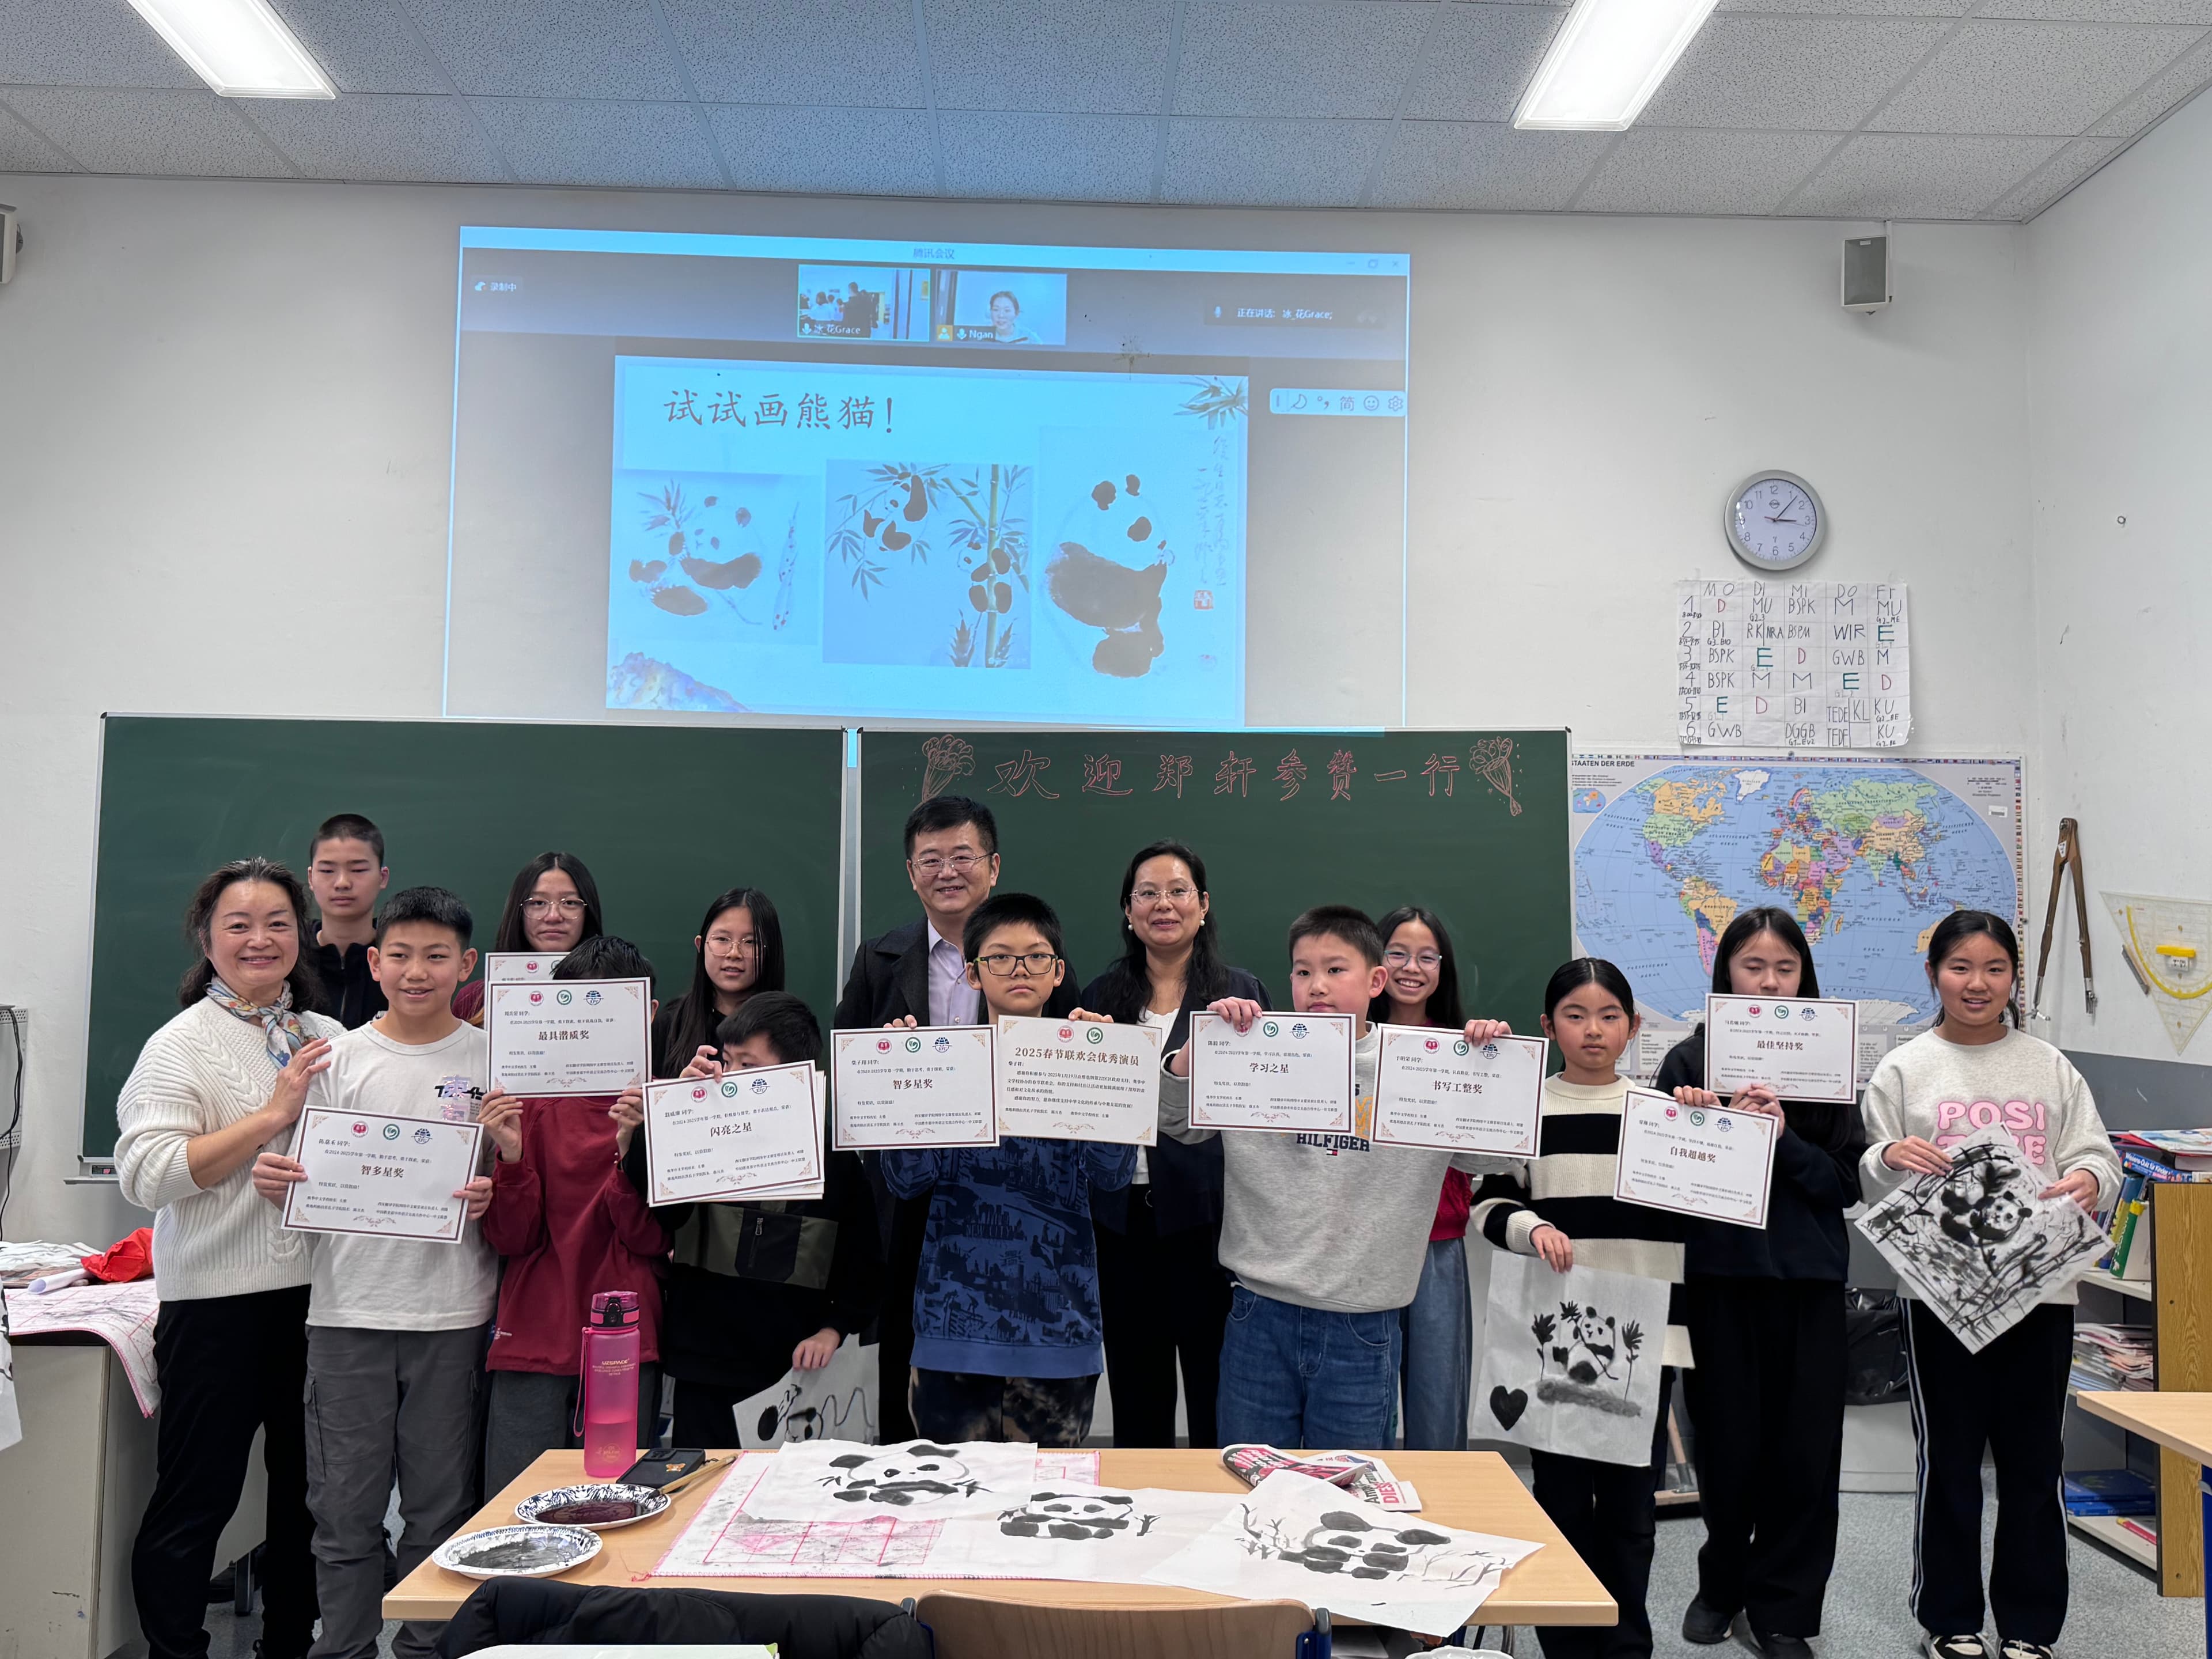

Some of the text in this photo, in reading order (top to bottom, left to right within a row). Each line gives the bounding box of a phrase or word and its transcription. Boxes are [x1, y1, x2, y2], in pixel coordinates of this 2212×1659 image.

[913, 247, 955, 260] 腾讯会议
[969, 329, 994, 339] Ngan
[1339, 395, 1355, 411] 简
[1755, 491, 1762, 499] 11
[1770, 485, 1778, 494] 12
[1789, 491, 1792, 499] 1
[1744, 500, 1753, 510] 10
[1798, 501, 1805, 510] 2
[1805, 516, 1810, 525] 3
[1744, 532, 1751, 541] 8
[1800, 532, 1805, 541] 4
[1757, 543, 1763, 552] 7
[1772, 546, 1778, 556] 6
[1788, 543, 1794, 551] 5
[1791, 584, 1807, 598] MI
[1838, 584, 1857, 598] DO
[1718, 599, 1726, 613] D
[1753, 597, 1772, 614] MU
[1789, 597, 1815, 615] BSPK
[1835, 597, 1853, 615] M
[1877, 600, 1902, 616] MU
[1682, 621, 1693, 638] 2
[1713, 620, 1725, 638] BI
[1834, 624, 1866, 641] WIR
[1878, 624, 1895, 642] E
[1684, 645, 1691, 662] 3
[1709, 647, 1734, 663] BSPK
[1757, 647, 1773, 667] E
[1798, 647, 1806, 664] D
[1832, 649, 1865, 665] GWB
[1877, 649, 1889, 665] M
[1685, 672, 1695, 687] 4
[1709, 672, 1734, 688] BSPK
[1752, 672, 1770, 689] M
[1793, 672, 1812, 690] M
[1843, 673, 1859, 690] E
[1881, 674, 1892, 691] D
[1685, 696, 1696, 713] 5
[1717, 696, 1728, 713] E
[1756, 696, 1768, 714] D
[1794, 698, 1806, 714] BI
[1853, 699, 1870, 720] KL
[1874, 698, 1895, 715] KU
[1687, 721, 1695, 737] 6
[1708, 721, 1741, 737] GWB
[1877, 724, 1895, 739] KU
[987, 749, 1460, 801] 欢迎郑轩参赞一行
[539, 1030, 589, 1040] 最具潜质奖
[1758, 1040, 1803, 1051] 最佳坚持奖
[1015, 1045, 1139, 1066] 2025春节联欢会优秀演员
[1249, 1063, 1289, 1073] 学习之星
[893, 1078, 933, 1089] 智多星奖
[1433, 1080, 1482, 1094] 书写工整奖
[1938, 1100, 2046, 1131] POSI
[710, 1122, 751, 1137] 闪亮之星
[1296, 1133, 1370, 1152] HILFIGER
[1670, 1145, 1716, 1163] 自我超越奖
[360, 1164, 404, 1178] 智多星奖
